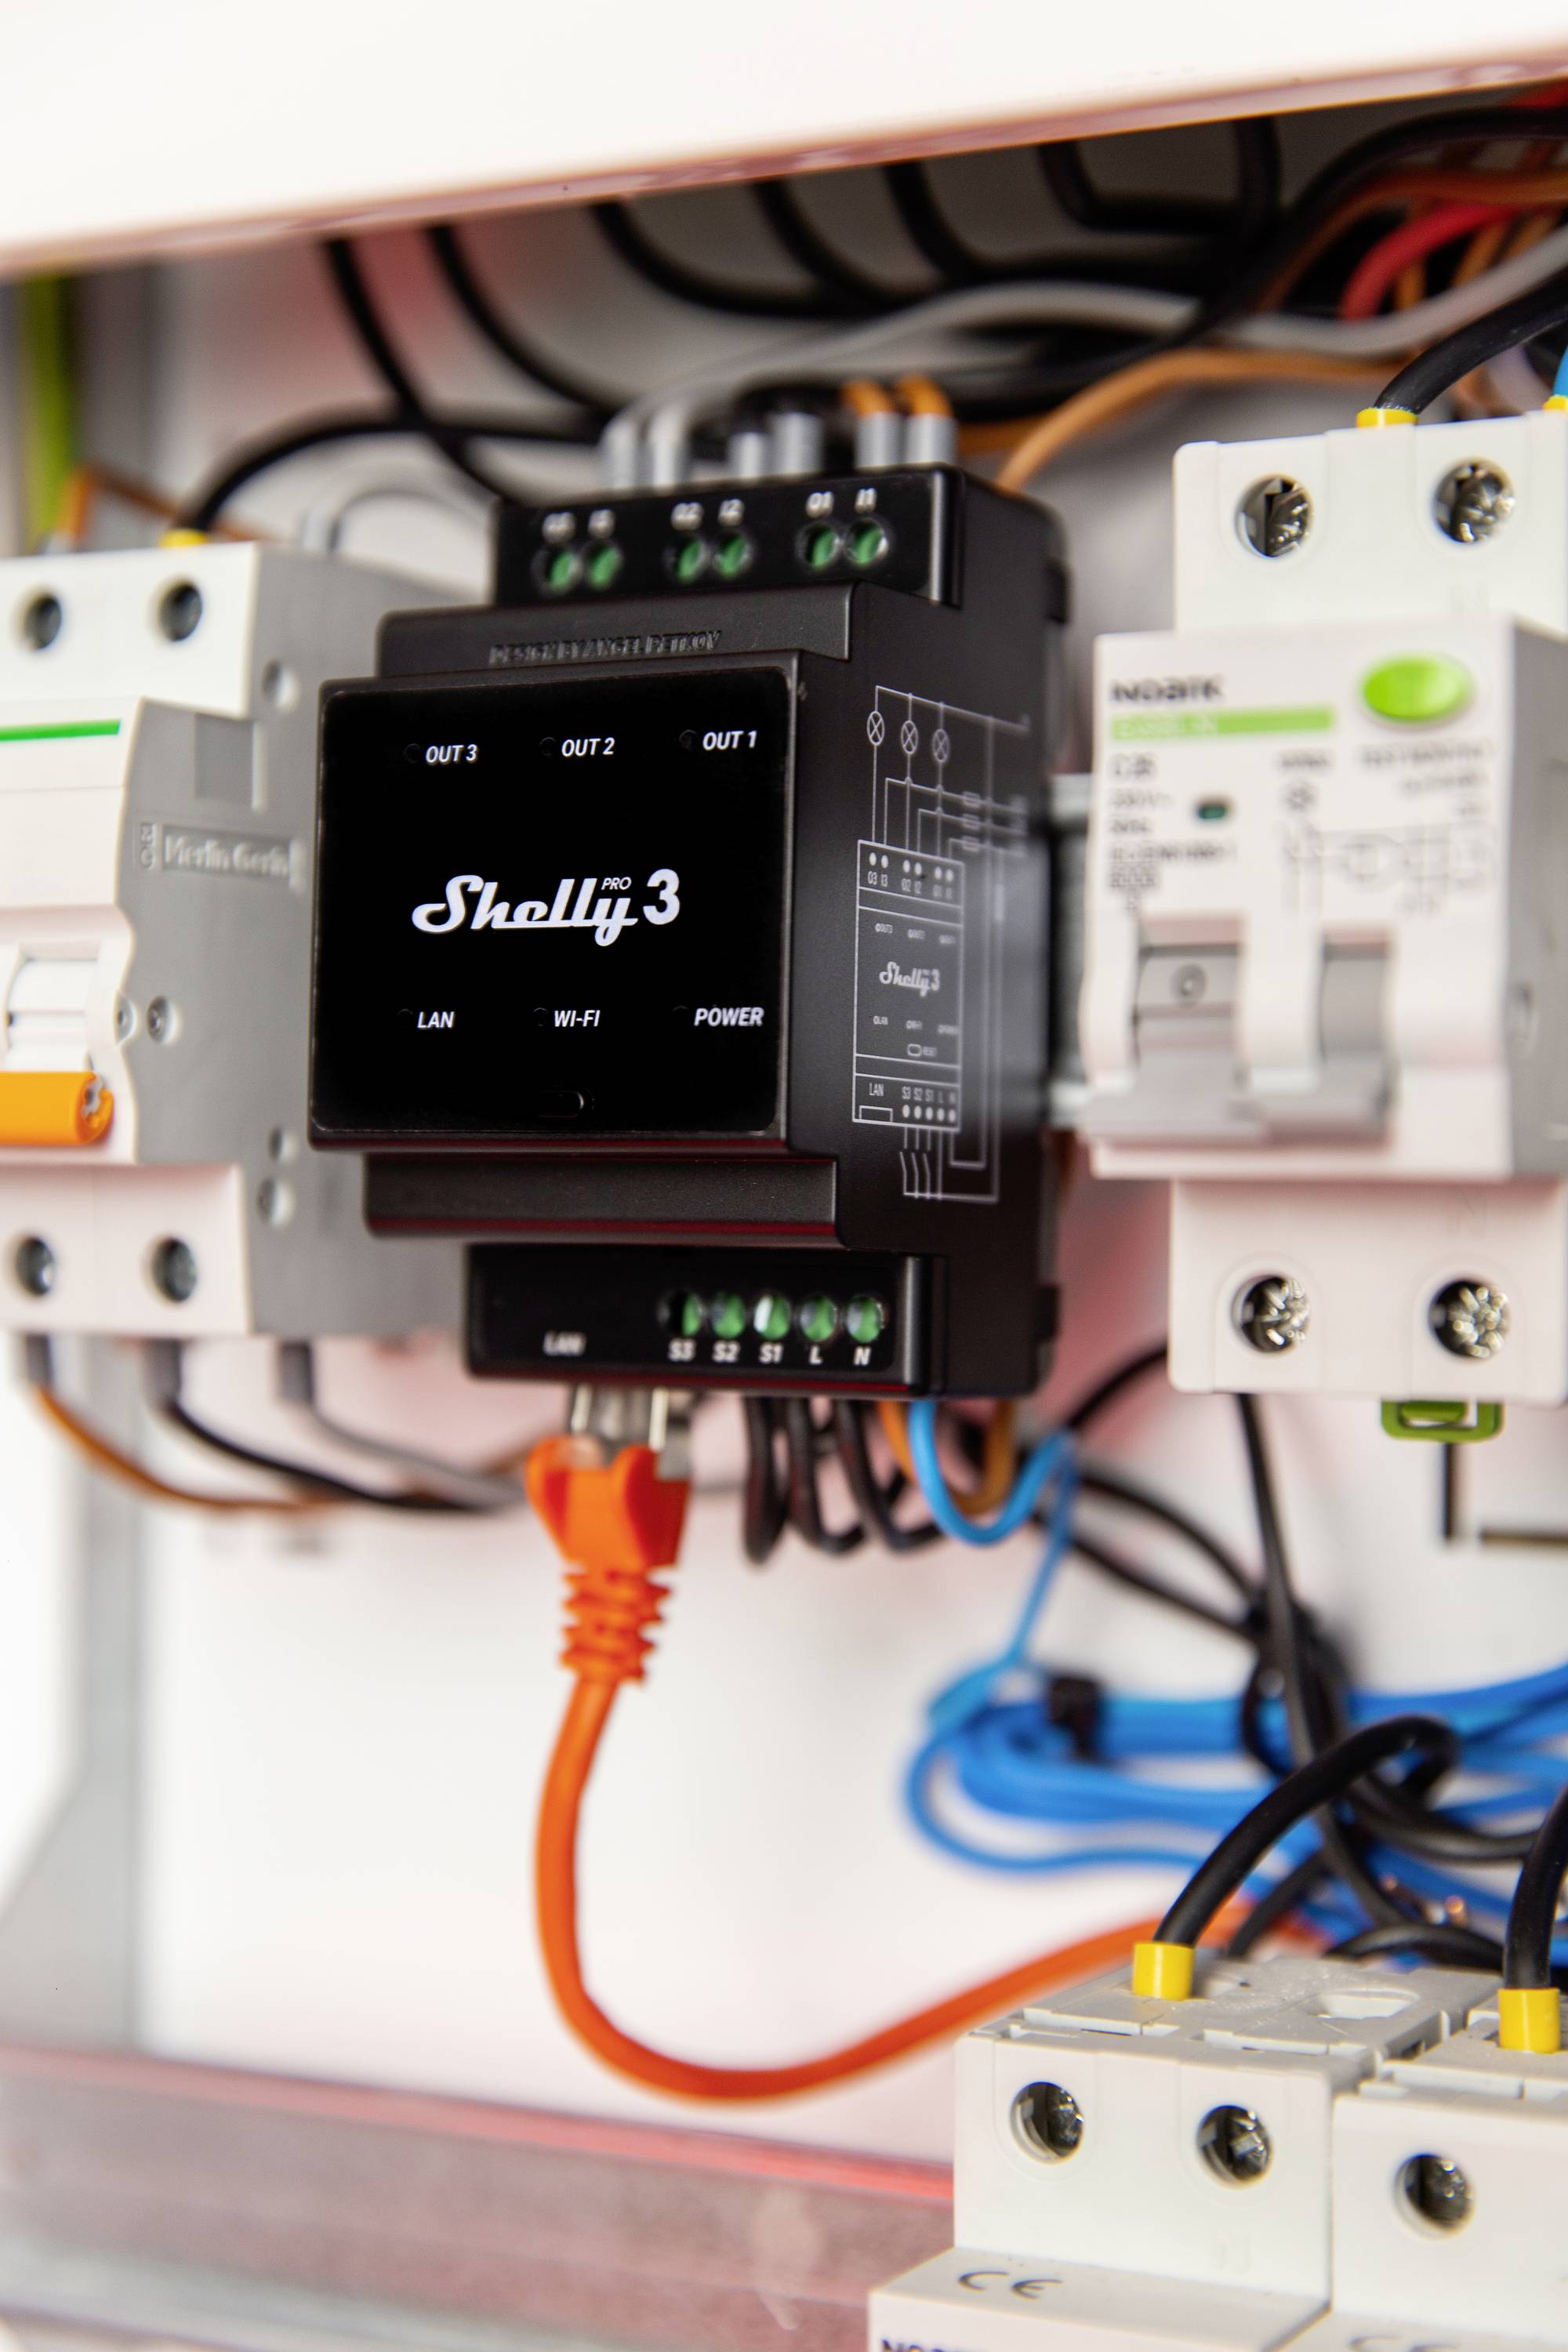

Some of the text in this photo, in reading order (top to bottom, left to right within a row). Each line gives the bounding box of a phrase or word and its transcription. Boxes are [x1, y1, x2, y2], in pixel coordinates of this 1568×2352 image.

[561, 737, 615, 757] OUT 2
[702, 730, 757, 750] OUT 1
[425, 743, 478, 764] OUT 3
[412, 868, 681, 947] Shelly PRO 3
[879, 961, 940, 997] Shelly 3
[416, 1011, 455, 1029] LAN
[554, 1009, 601, 1028] WI-FI
[693, 1007, 764, 1027] POWER
[869, 1083, 884, 1097] LAN
[669, 1338, 695, 1362] S3
[713, 1341, 740, 1363] S2
[759, 1342, 783, 1363] S1
[809, 1345, 822, 1365] L
[853, 1346, 872, 1366] N
